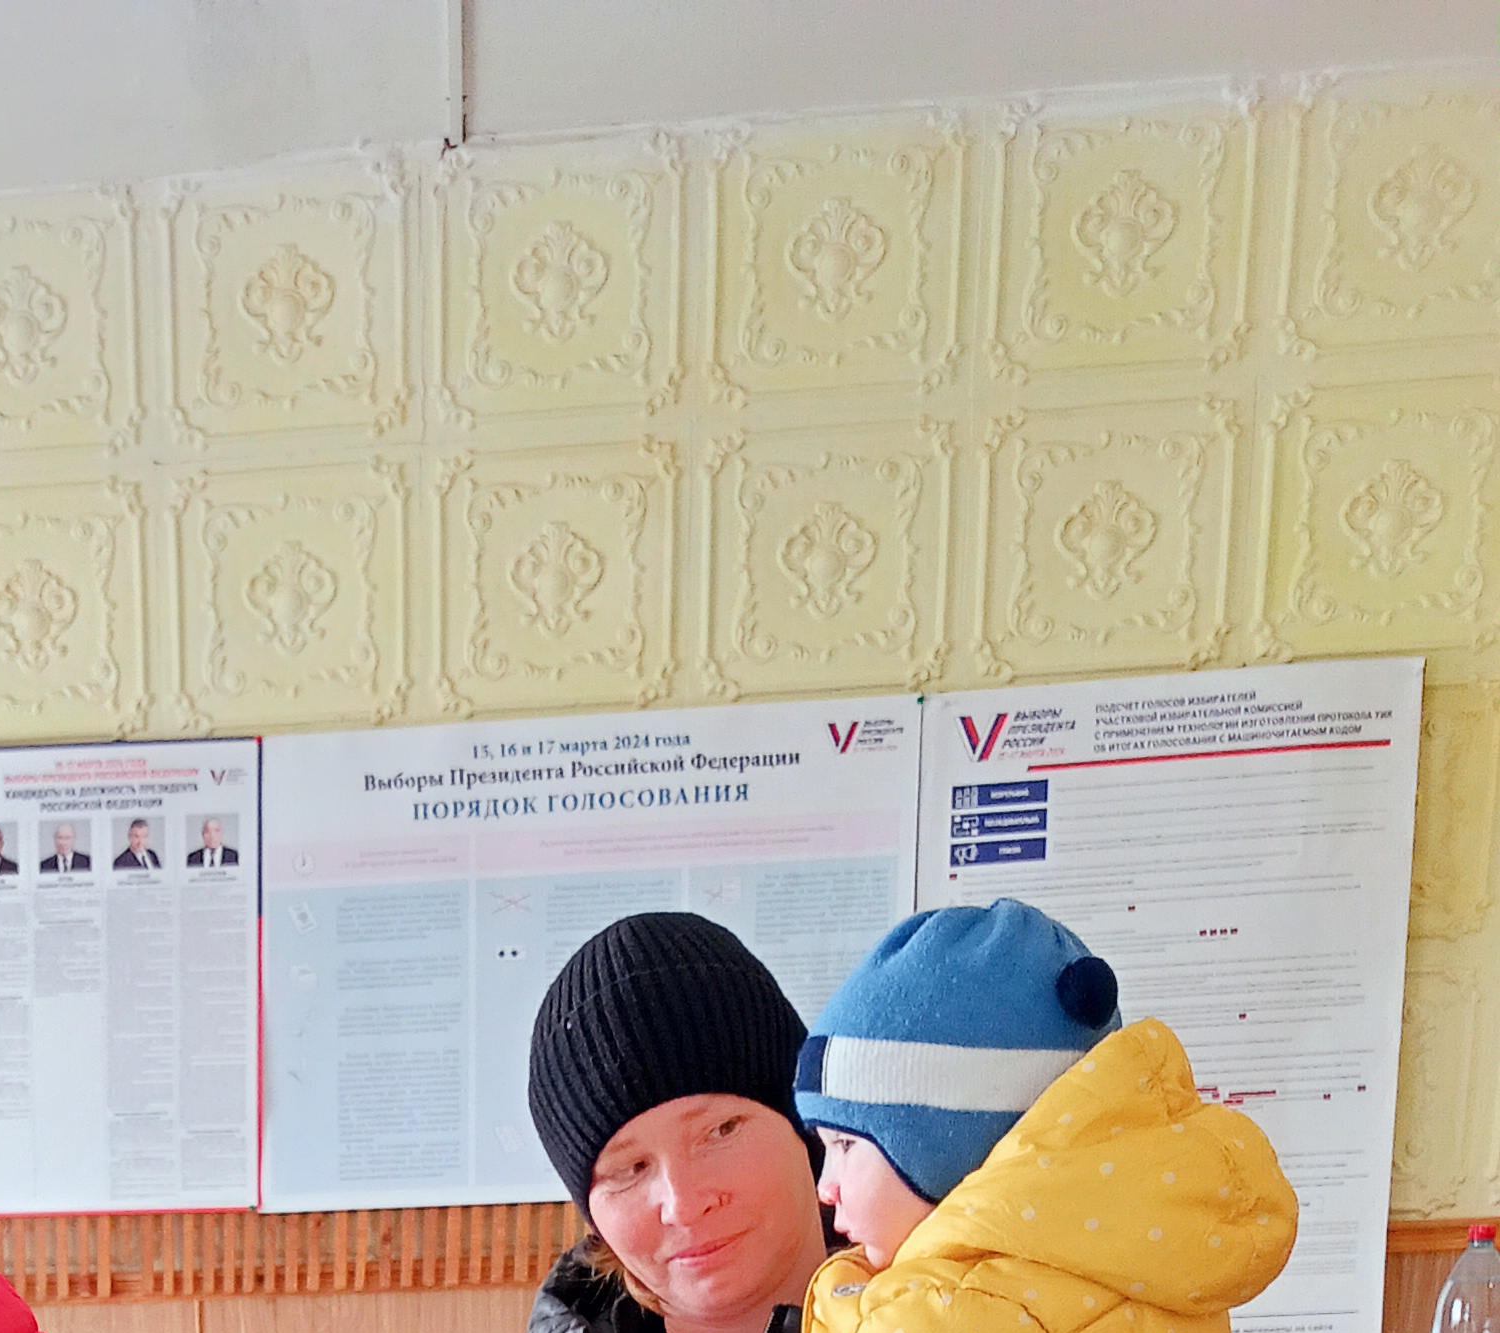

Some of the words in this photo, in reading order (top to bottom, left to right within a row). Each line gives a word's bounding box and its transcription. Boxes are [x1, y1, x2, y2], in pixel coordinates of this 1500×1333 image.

[473, 744, 495, 760] 15,
[500, 743, 518, 758] 16
[522, 745, 532, 756] и
[538, 740, 556, 756] 17
[559, 740, 608, 757] марта
[614, 734, 650, 750] 2024
[655, 734, 691, 748] года
[364, 771, 444, 793] Выборы
[450, 764, 565, 790] Президента
[571, 755, 684, 779] Российской
[691, 751, 802, 773] Федерации
[413, 796, 539, 821] ПОРЯДОК
[548, 783, 750, 813] ГОЛОСОВАНИЯ
